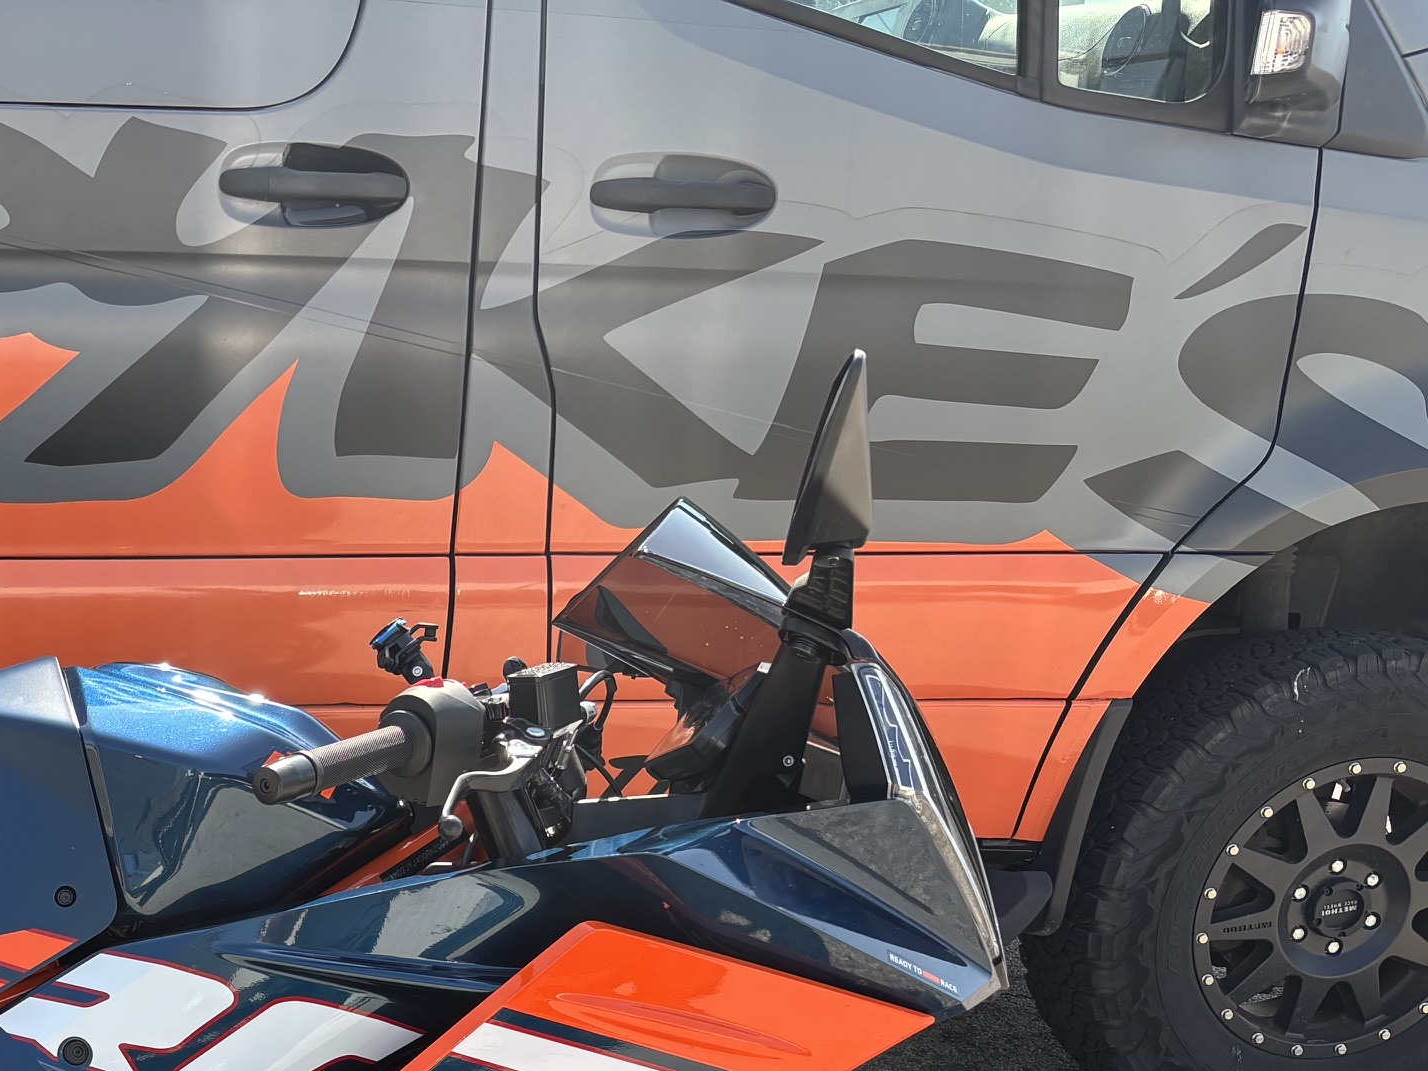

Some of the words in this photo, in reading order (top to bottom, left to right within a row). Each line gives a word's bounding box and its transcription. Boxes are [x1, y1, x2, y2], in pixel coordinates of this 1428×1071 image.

[889, 952, 912, 971] READY
[912, 964, 923, 976] TO
[939, 978, 959, 994] RACE
